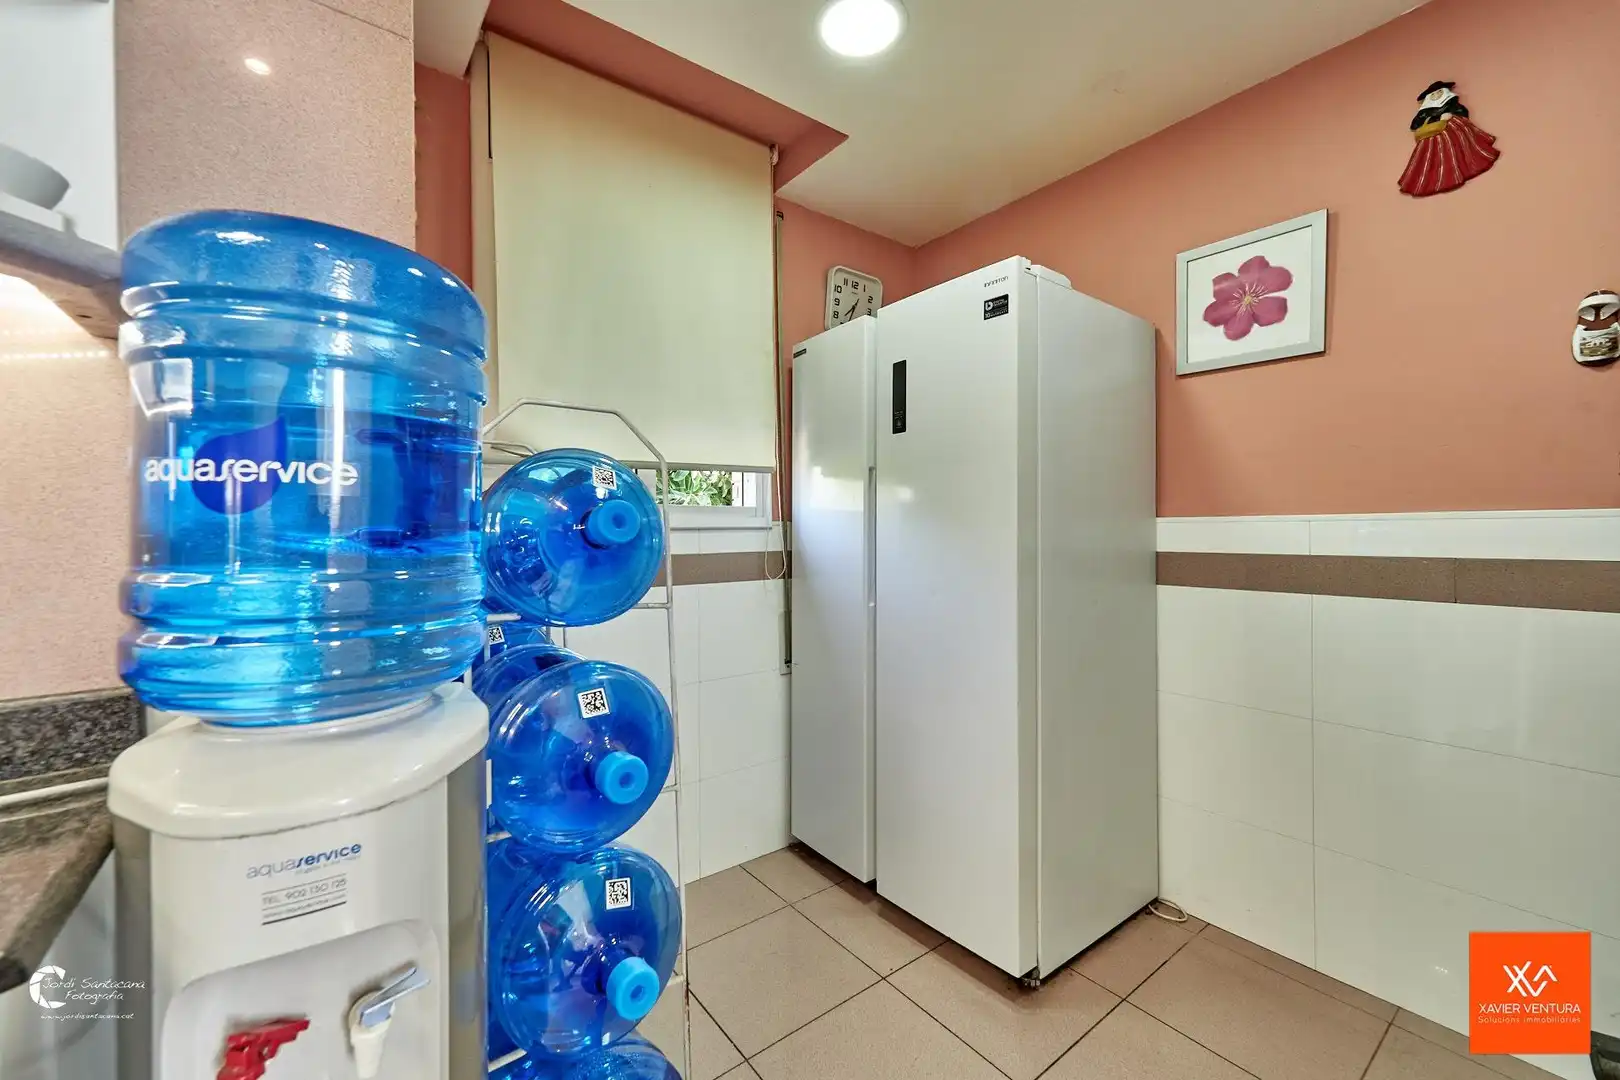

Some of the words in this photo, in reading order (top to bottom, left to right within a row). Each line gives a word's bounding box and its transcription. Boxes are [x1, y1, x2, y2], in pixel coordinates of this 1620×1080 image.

[843, 277, 849, 287] 11
[851, 280, 859, 290] 12
[834, 284, 842, 293] 10
[834, 297, 840, 306] 9
[867, 295, 873, 304] 2
[833, 310, 839, 319] 8
[144, 458, 359, 494] aquaservice
[246, 843, 362, 879] aquaservice
